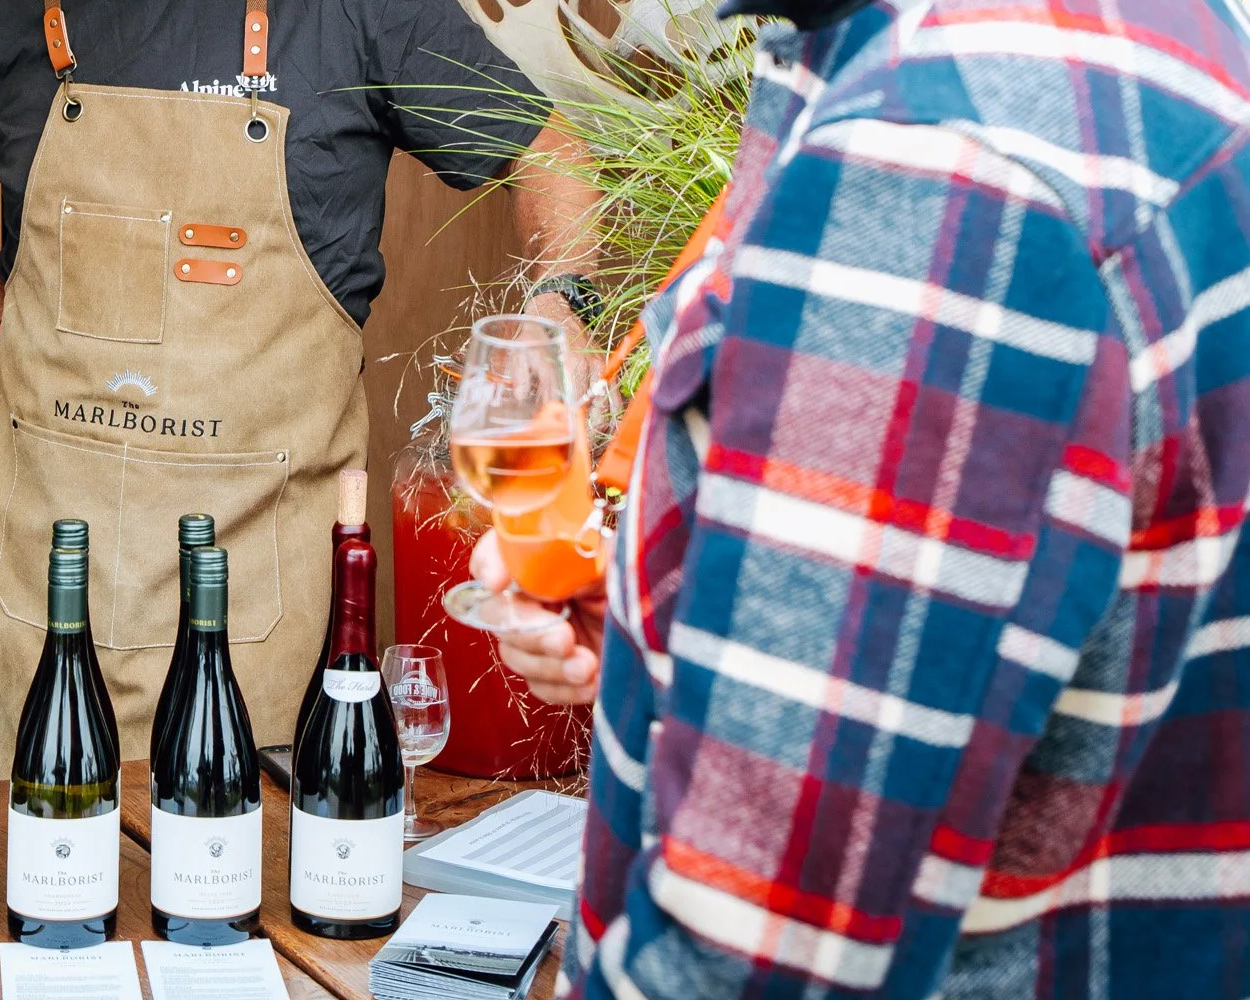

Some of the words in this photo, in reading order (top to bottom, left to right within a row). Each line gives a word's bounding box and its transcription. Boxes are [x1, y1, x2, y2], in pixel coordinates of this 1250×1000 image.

[121, 400, 140, 409] The
[53, 399, 223, 438] MARLBORIST
[23, 872, 104, 887] MARLBORIST
[173, 869, 254, 885] MARLBORIST
[304, 870, 387, 887] MARLBORIST
